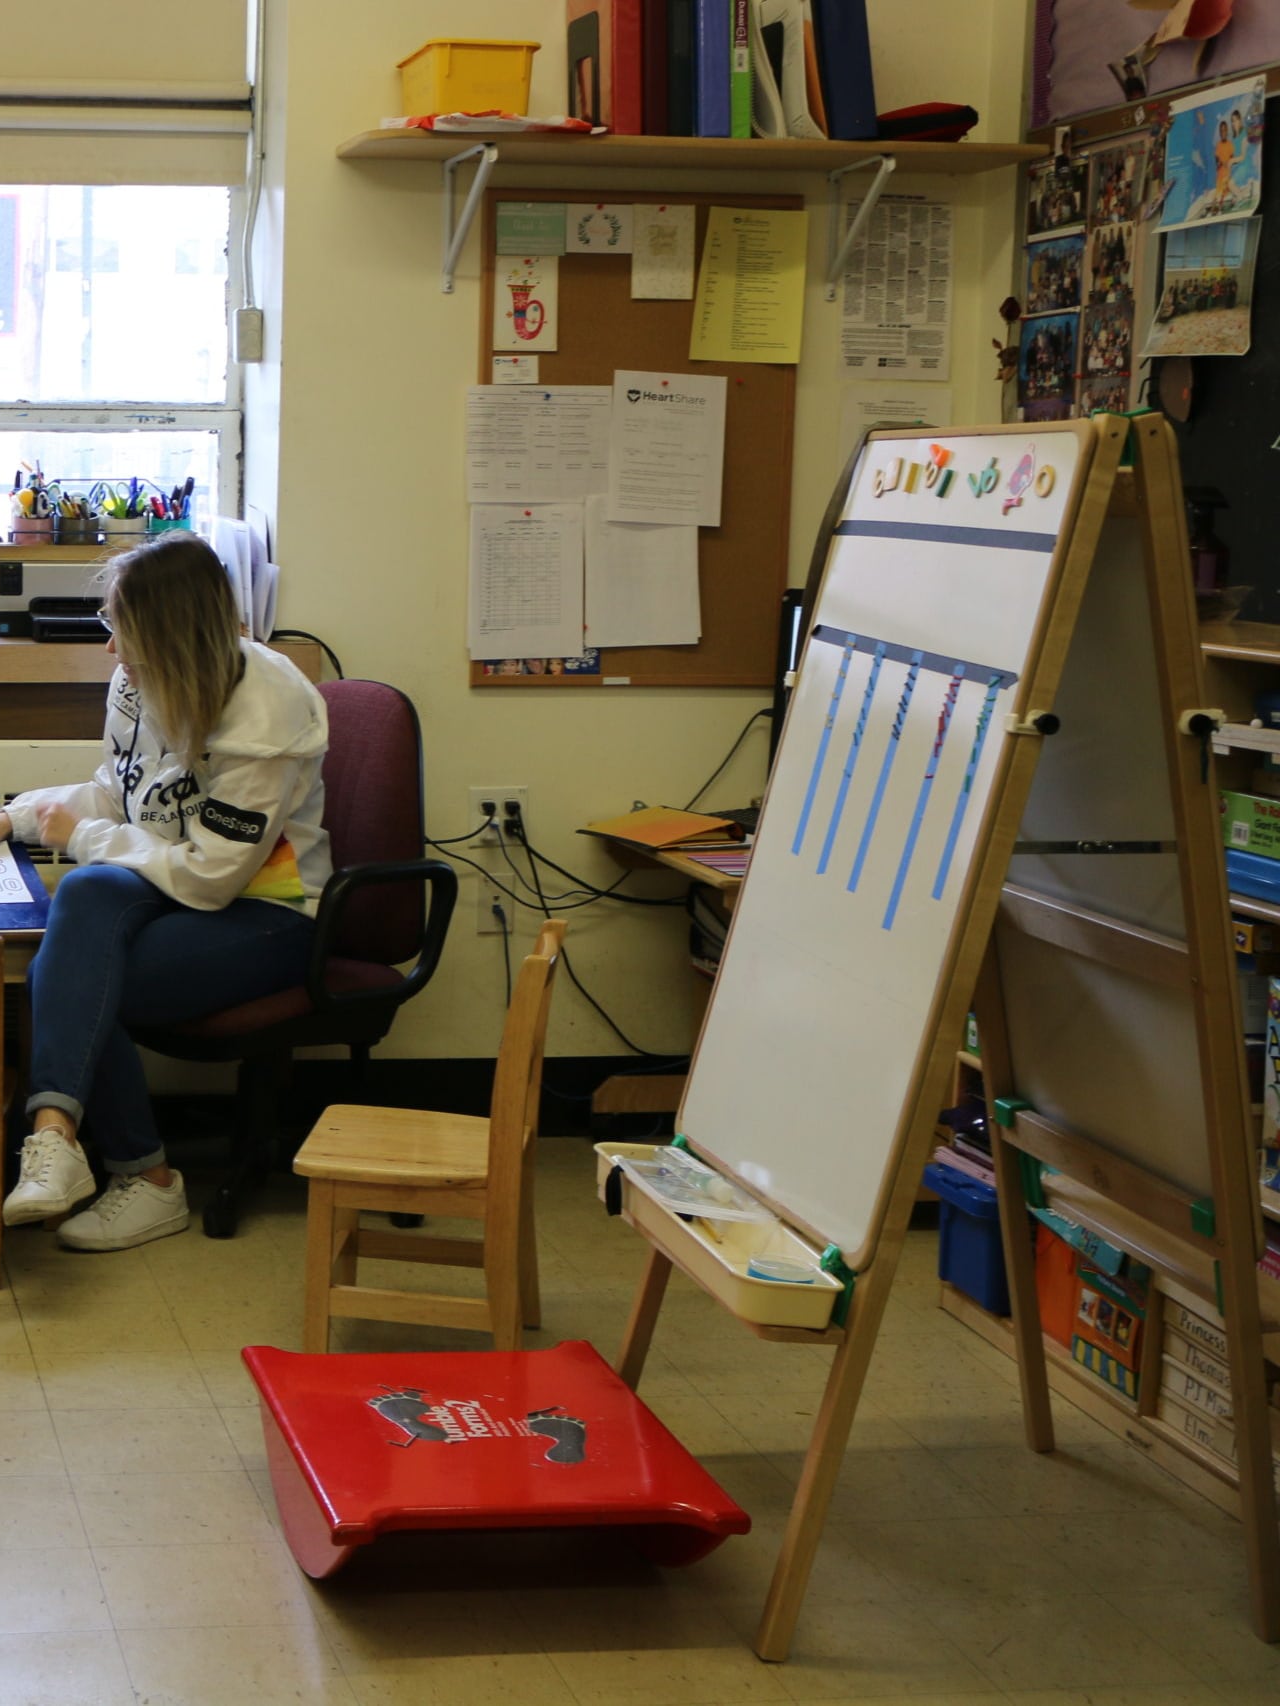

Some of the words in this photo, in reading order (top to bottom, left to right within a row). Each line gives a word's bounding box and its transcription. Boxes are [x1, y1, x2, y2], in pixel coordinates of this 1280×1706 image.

[642, 390, 707, 406] HeartShare
[141, 811, 158, 822] BE
[205, 807, 259, 835] OneStep
[1179, 1309, 1227, 1354] Princess
[1184, 1343, 1231, 1389] Thomas
[1183, 1374, 1202, 1402] PJ
